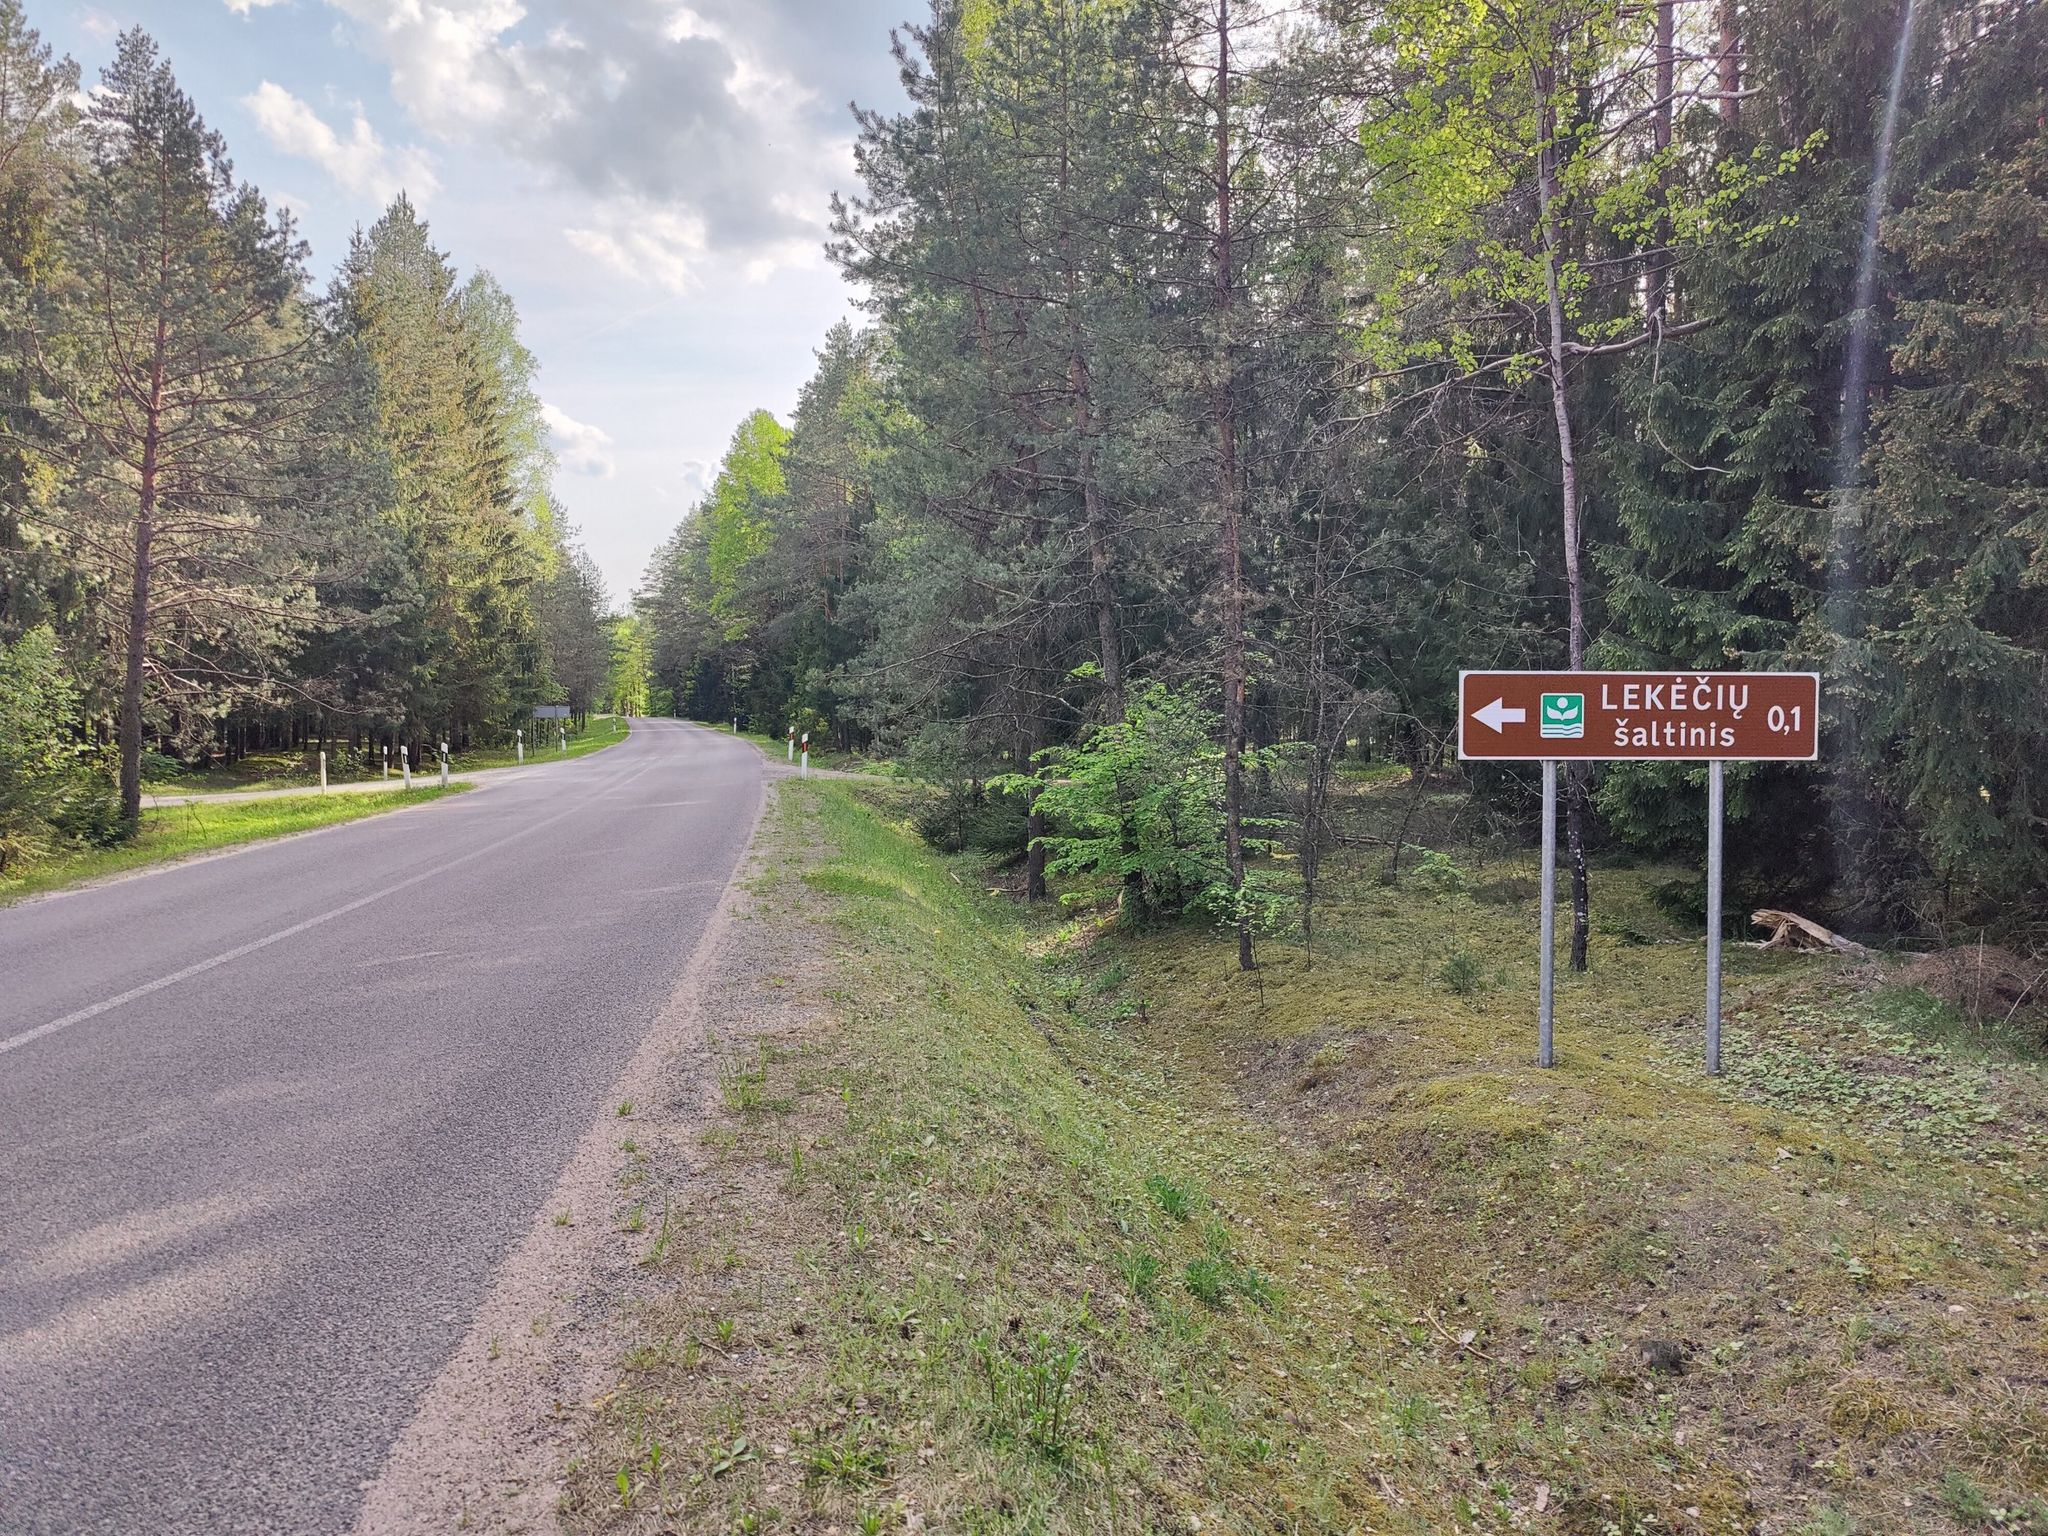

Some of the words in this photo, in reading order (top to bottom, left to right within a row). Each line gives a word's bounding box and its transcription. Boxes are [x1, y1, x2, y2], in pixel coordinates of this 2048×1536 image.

[1601, 676, 1749, 719] LEKĖČIŲ
[1614, 717, 1736, 747] šaltinis
[1767, 705, 1801, 736] 0,1
